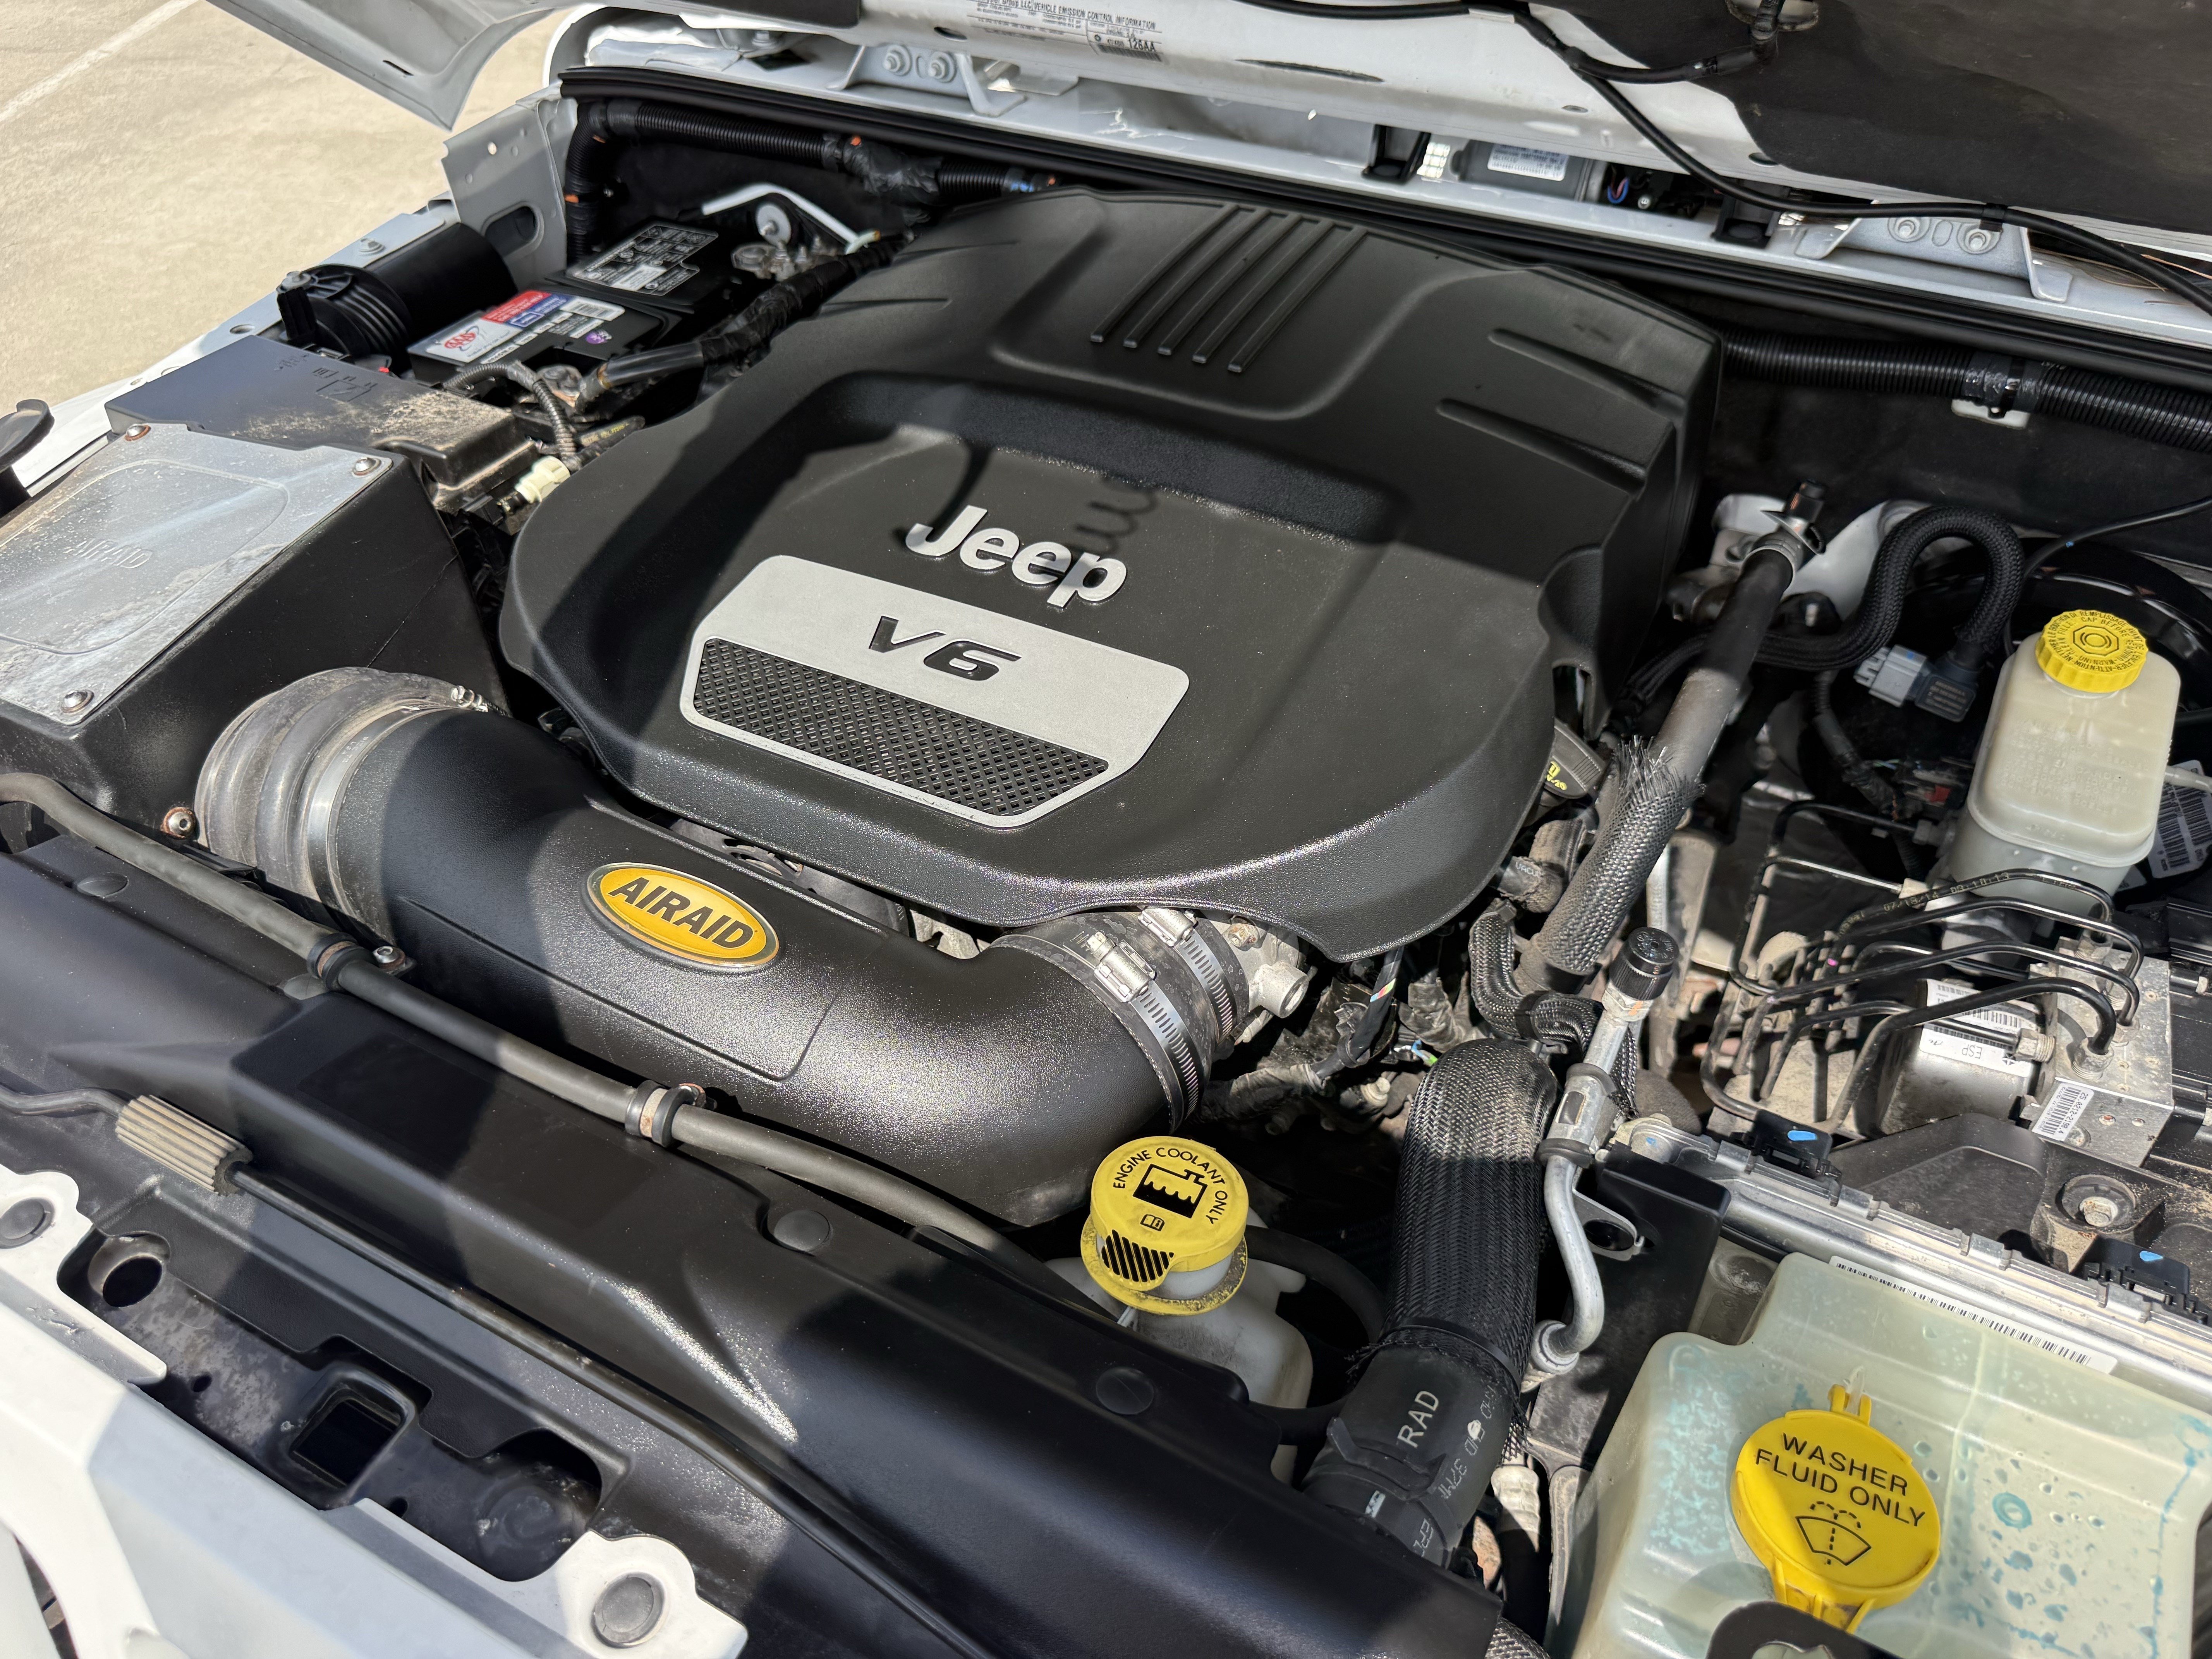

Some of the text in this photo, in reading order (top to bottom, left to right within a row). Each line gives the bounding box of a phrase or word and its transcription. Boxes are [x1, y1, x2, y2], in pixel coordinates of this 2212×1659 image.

[1034, 2, 1056, 13] VEHICLE
[1087, 10, 1113, 23] CONTROL
[1116, 14, 1156, 30] INFORMATION
[905, 505, 1127, 608] Jeep
[868, 615, 1022, 681] V6
[2080, 611, 2128, 628] REMPLISSAGE
[2101, 620, 2130, 637] BEFORE
[608, 877, 755, 949] AIRAID
[1961, 1044, 1983, 1060] ESP
[1113, 1147, 1228, 1224] ENGINE COOLANT ONLY
[1396, 1391, 1439, 1448] RAD
[1755, 1448, 1925, 1527] FLUID ONLY
[1782, 1432, 1908, 1496] WASHER
